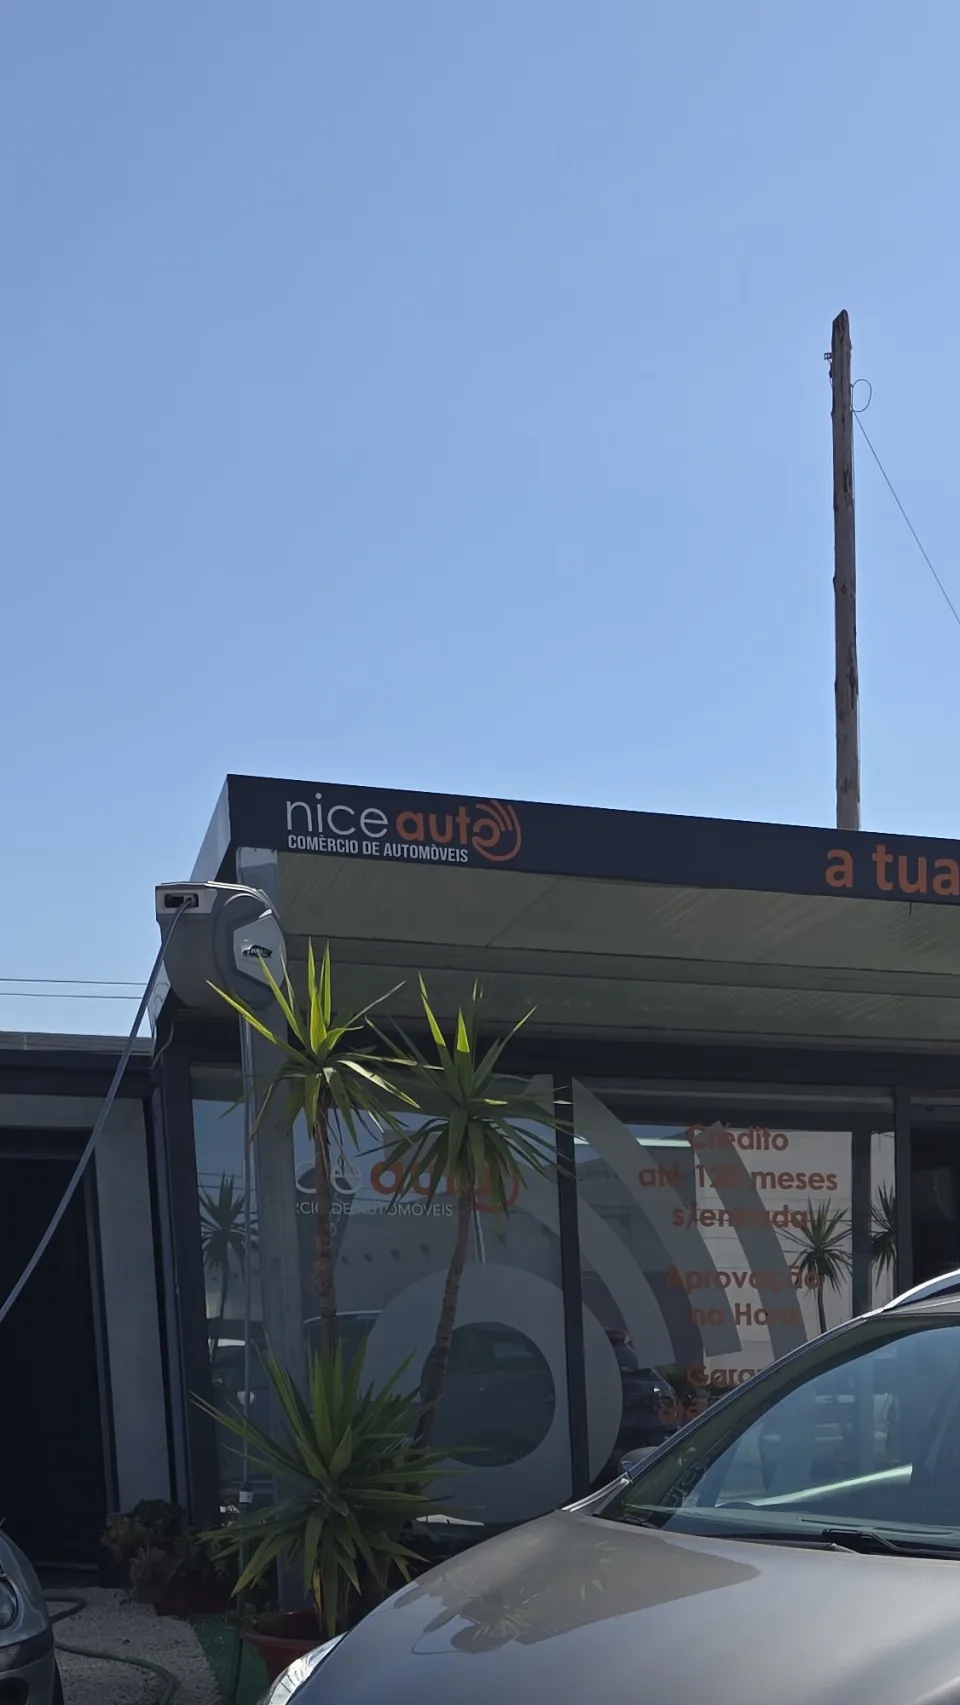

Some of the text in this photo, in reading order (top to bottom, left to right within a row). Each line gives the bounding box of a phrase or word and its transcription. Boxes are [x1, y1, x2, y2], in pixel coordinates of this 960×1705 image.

[286, 793, 522, 862] nice auto
[363, 840, 381, 856] DE
[825, 849, 853, 888] a
[872, 844, 960, 896] tua
[685, 1122, 789, 1151] Crédito
[751, 1170, 838, 1191] meses
[666, 1264, 821, 1294] Aprovação
[690, 1303, 799, 1326] na Hora
